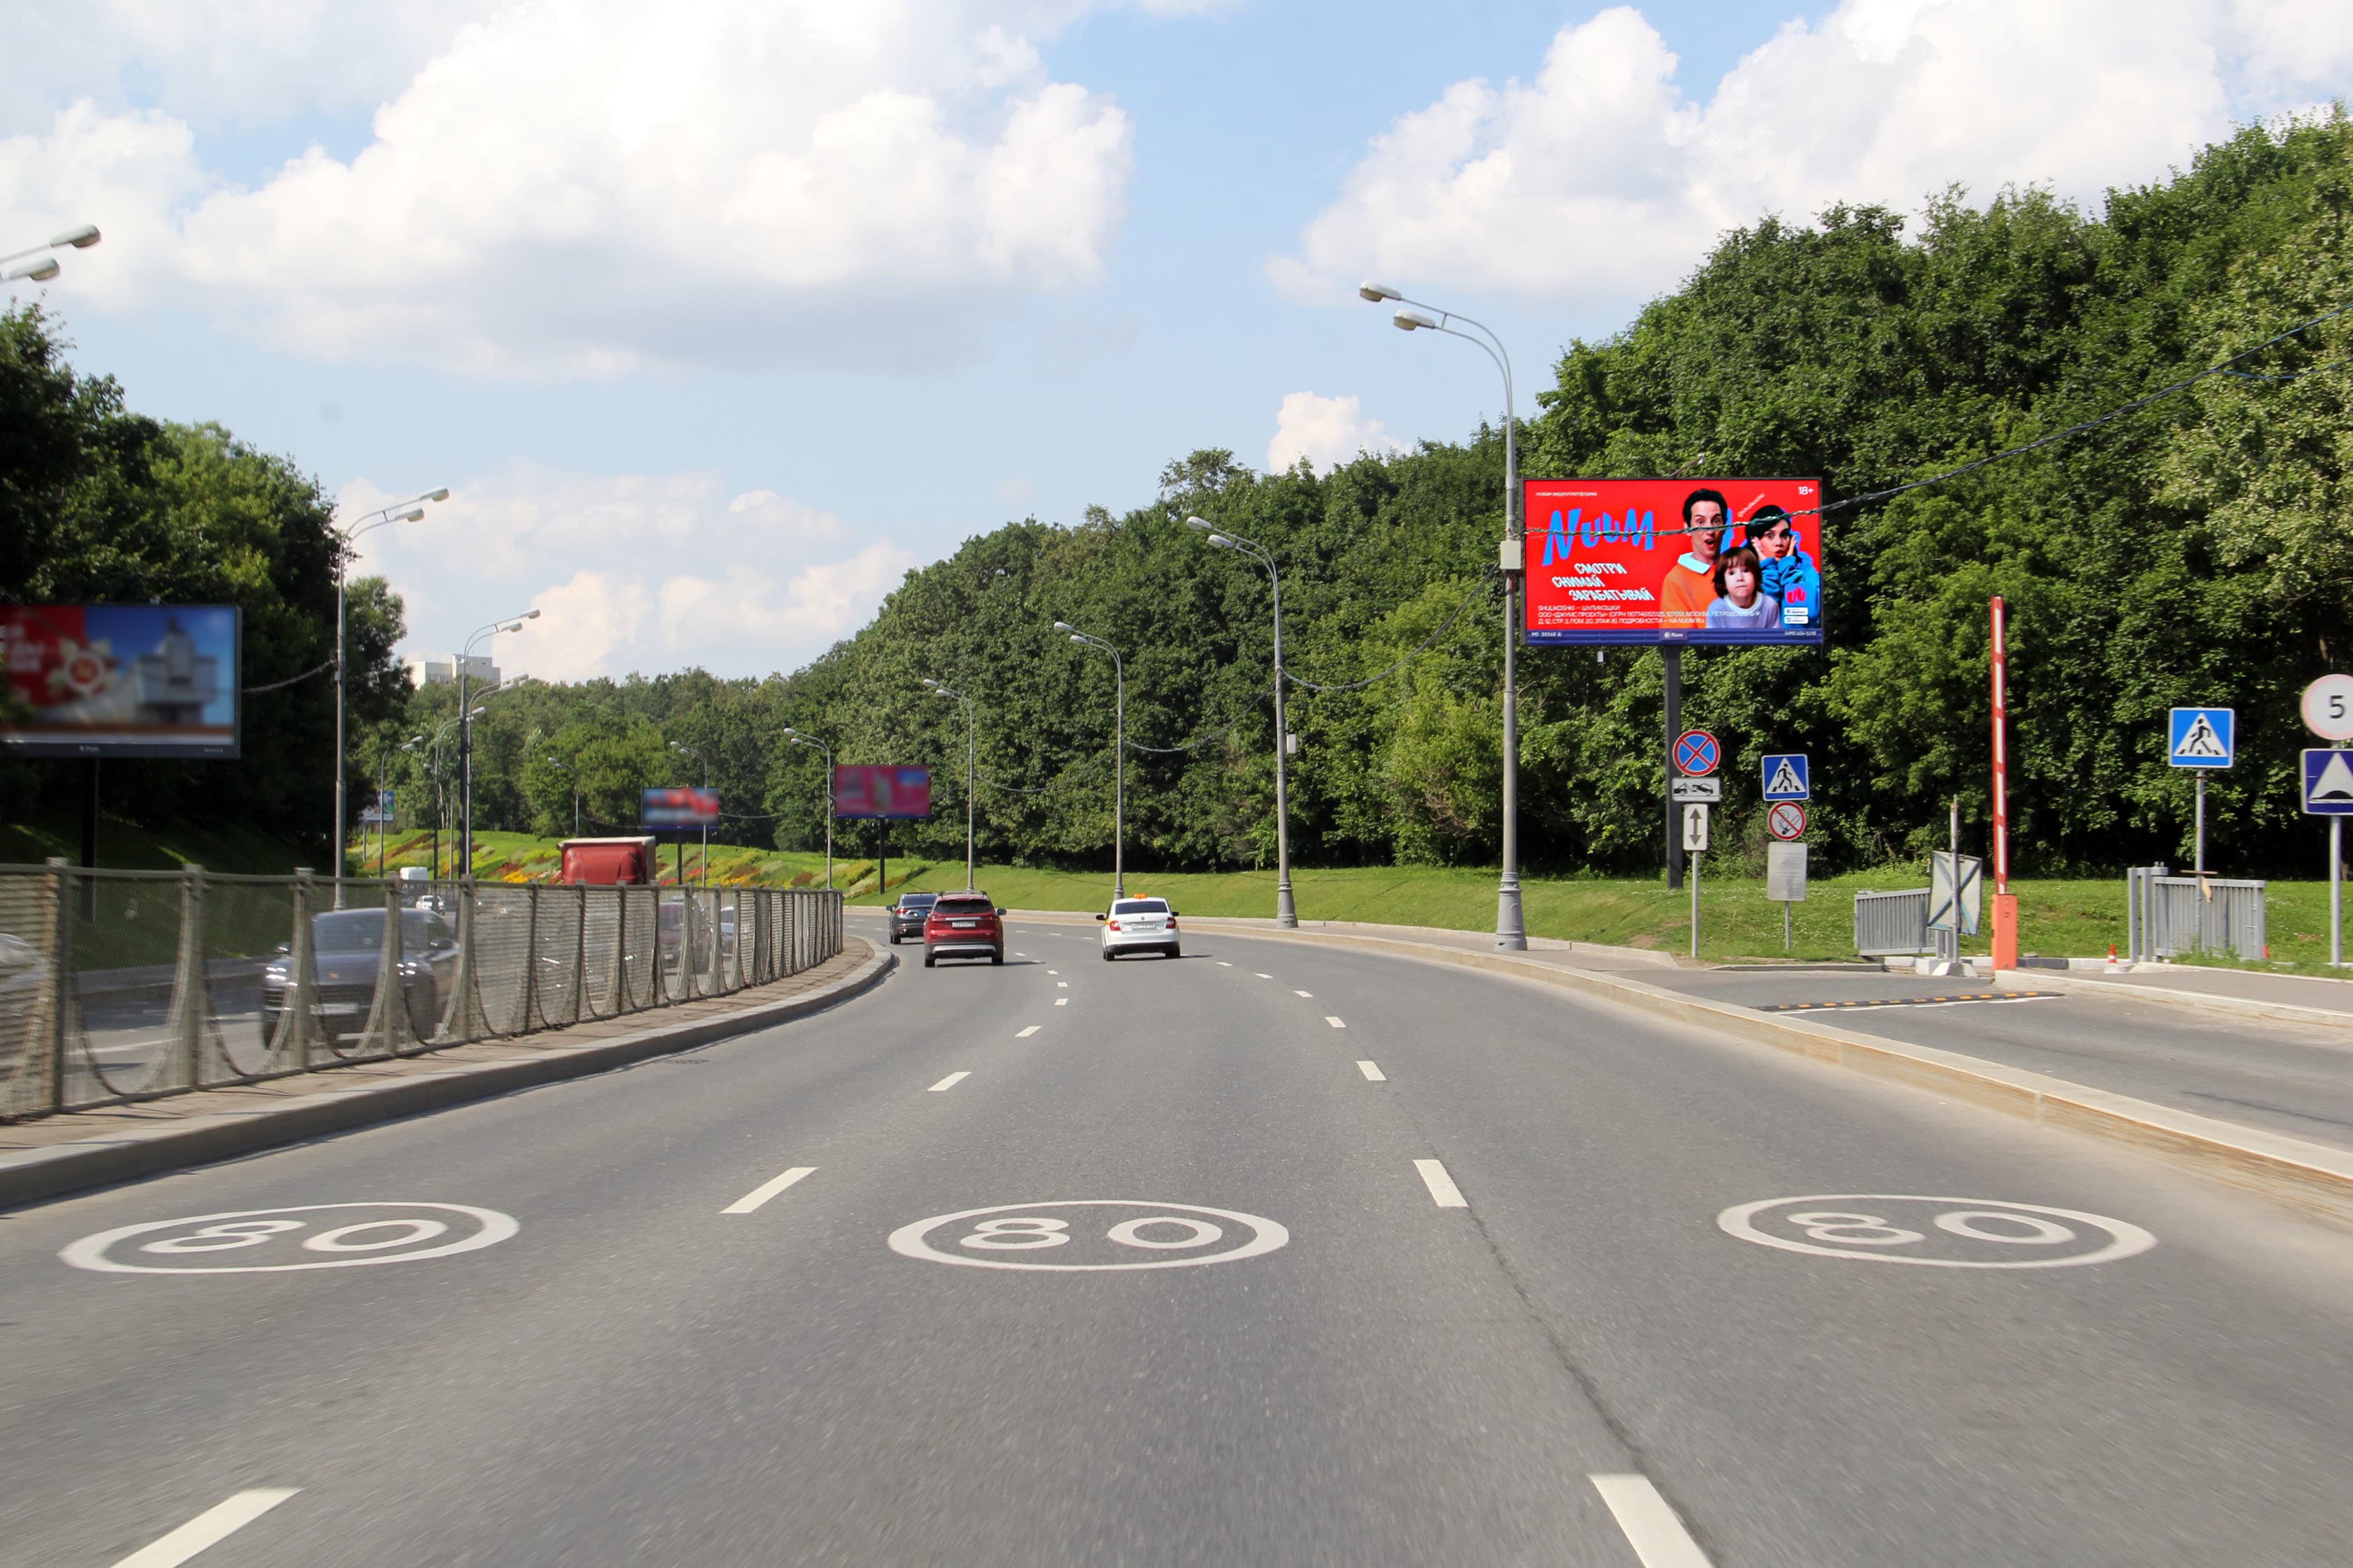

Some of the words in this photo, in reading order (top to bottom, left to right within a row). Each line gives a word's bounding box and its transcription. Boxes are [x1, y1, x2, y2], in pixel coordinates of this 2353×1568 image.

[1798, 486, 1814, 495] 18+
[1574, 562, 1628, 574] СМОТРИ
[1552, 574, 1606, 588] СНИМАЙ
[1568, 587, 1655, 601] ЗАРАБАТЫВАЙ
[2329, 694, 2345, 719] 5
[139, 1218, 449, 1253] 80
[959, 1216, 1222, 1250] 80
[1786, 1210, 2077, 1246] 80
